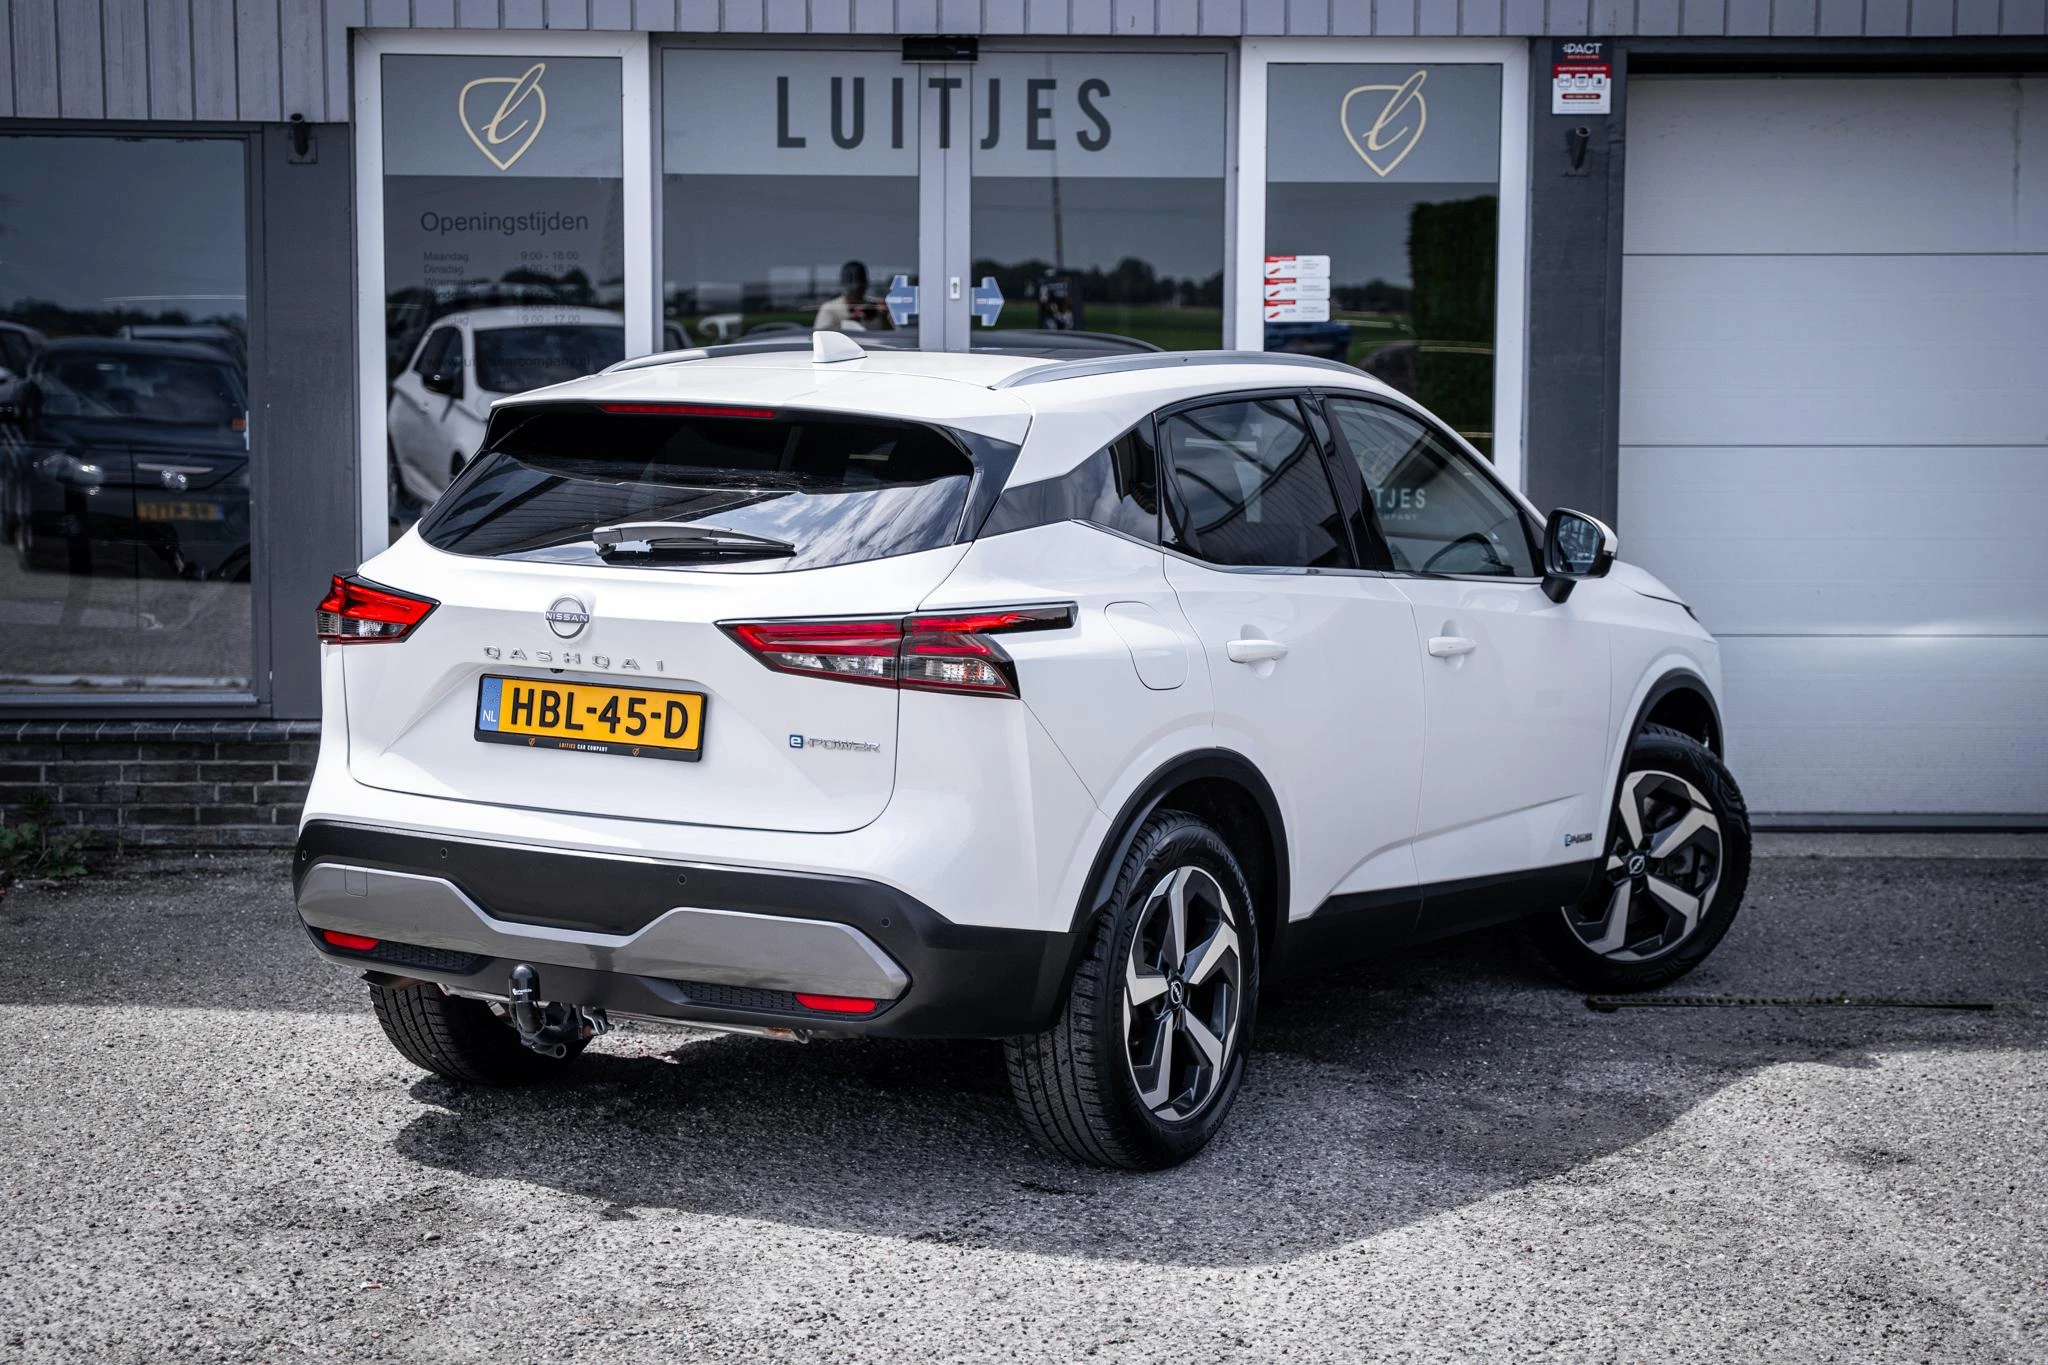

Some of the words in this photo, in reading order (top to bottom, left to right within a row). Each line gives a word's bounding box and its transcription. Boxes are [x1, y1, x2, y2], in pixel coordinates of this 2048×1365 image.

[777, 76, 1111, 152] LUITJES
[420, 211, 588, 236] Openingstijden
[1375, 487, 1427, 509] TJES
[547, 612, 588, 622] NISSAN
[484, 646, 664, 672] QASHQAI
[482, 709, 497, 723] NL
[511, 687, 689, 740] HBL-45-D
[587, 744, 608, 752] COMPANY
